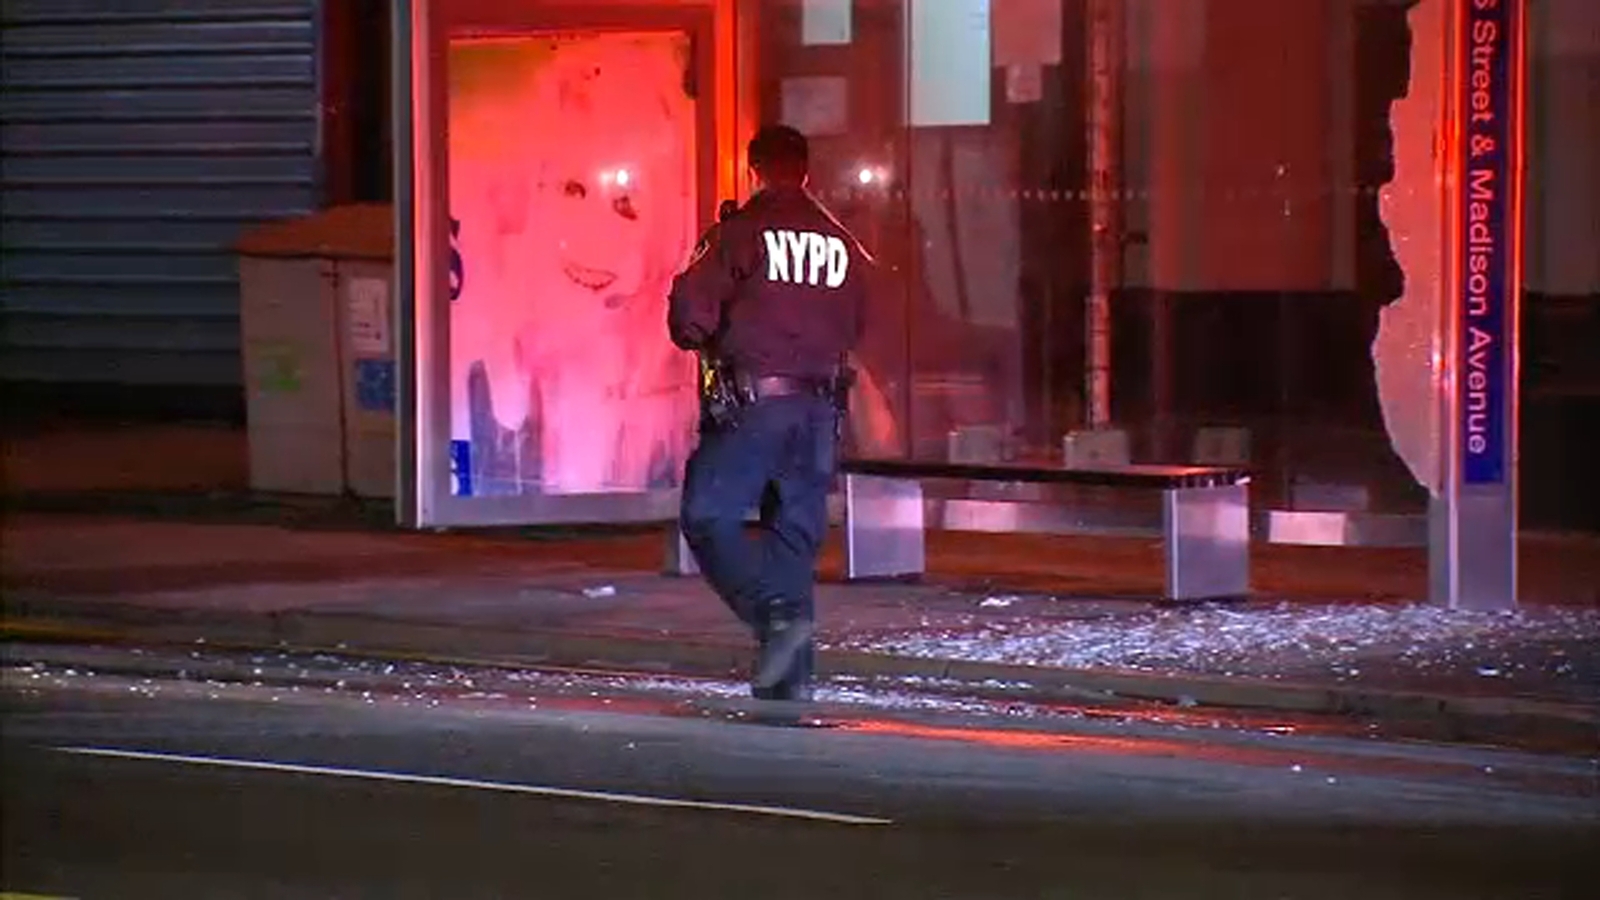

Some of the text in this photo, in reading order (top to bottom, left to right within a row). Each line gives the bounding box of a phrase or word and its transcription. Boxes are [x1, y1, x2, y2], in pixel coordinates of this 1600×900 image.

[1472, 20, 1496, 122] Street
[1470, 134, 1495, 157] &
[763, 230, 848, 288] NYPD
[1469, 169, 1494, 313] Madison
[1467, 327, 1491, 454] Avenue
